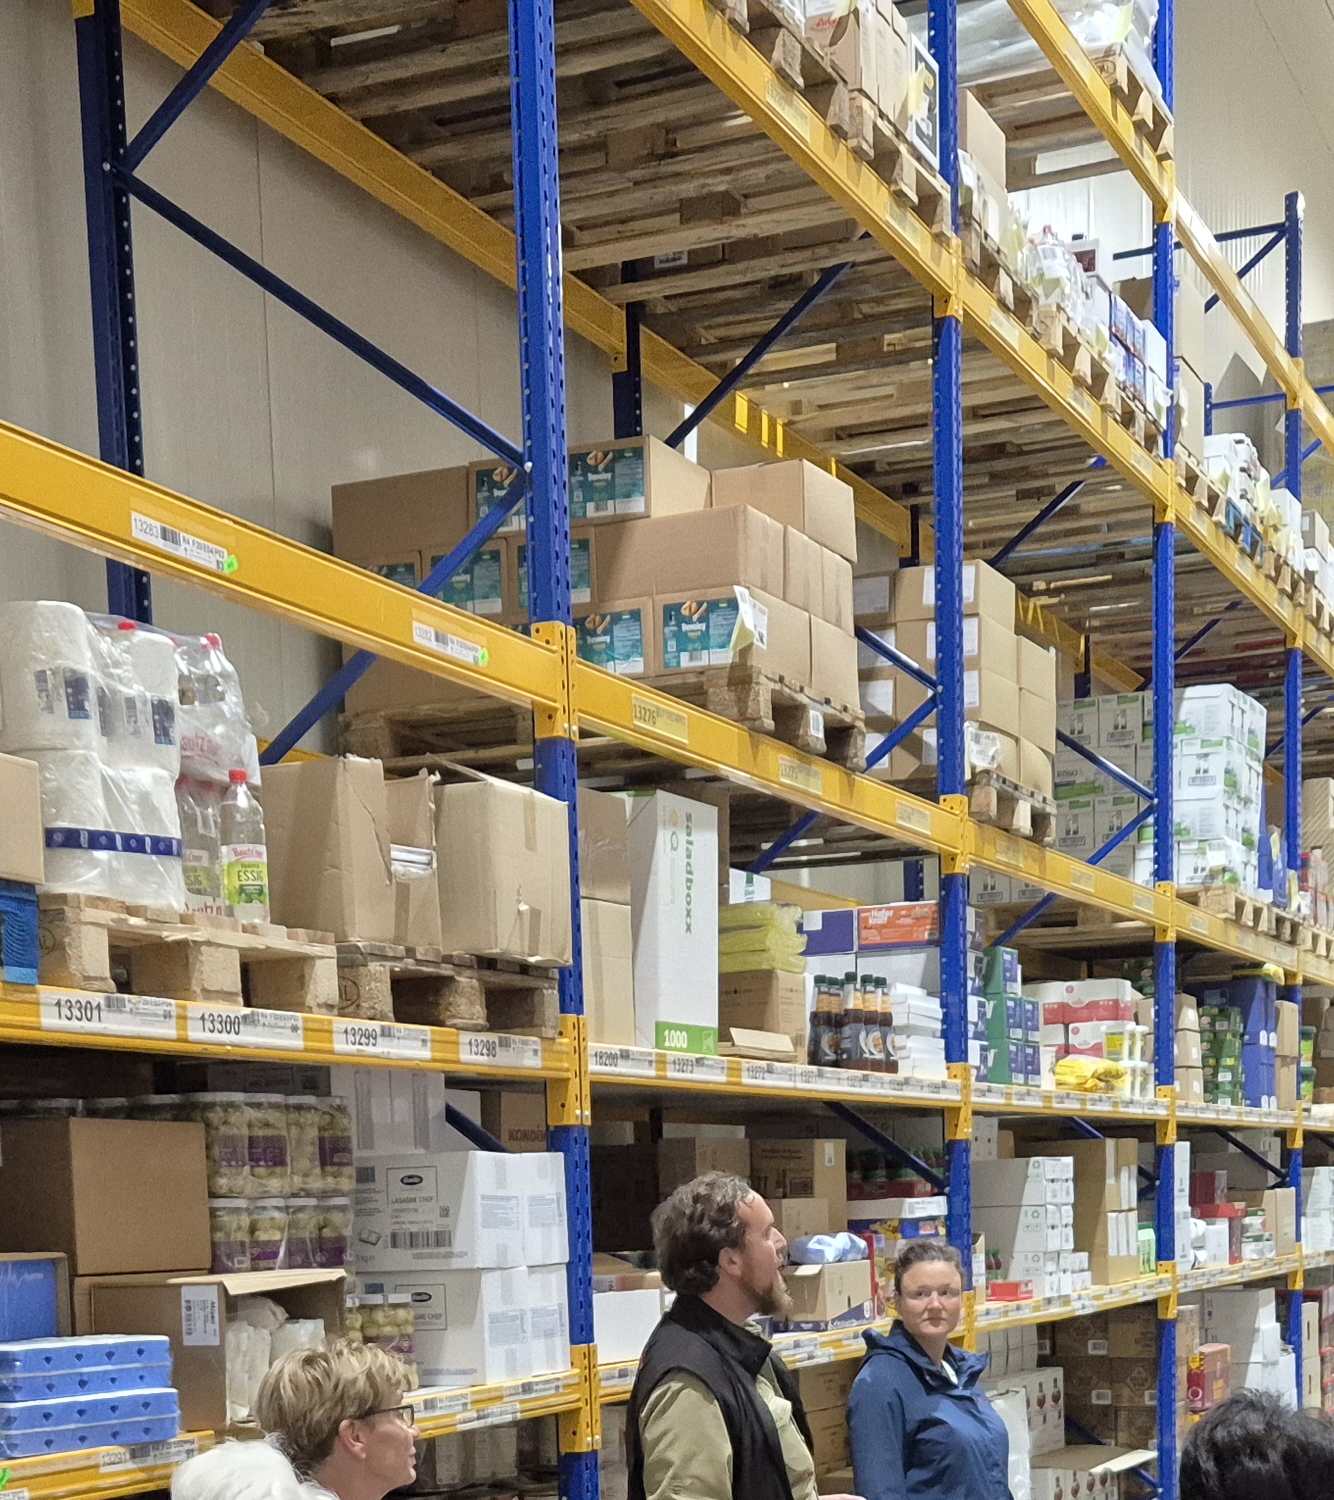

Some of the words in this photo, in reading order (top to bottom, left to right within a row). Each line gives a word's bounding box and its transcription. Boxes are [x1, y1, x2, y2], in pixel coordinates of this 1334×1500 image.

[133, 517, 159, 539] 13283
[633, 703, 657, 726] 13276
[237, 869, 264, 882] ESSIG
[53, 998, 103, 1023] 13301
[199, 1012, 241, 1036] 13300
[342, 1026, 377, 1047] 13299
[663, 1028, 688, 1049] 1000
[467, 1037, 497, 1058] 13298
[593, 1050, 619, 1068] 18200
